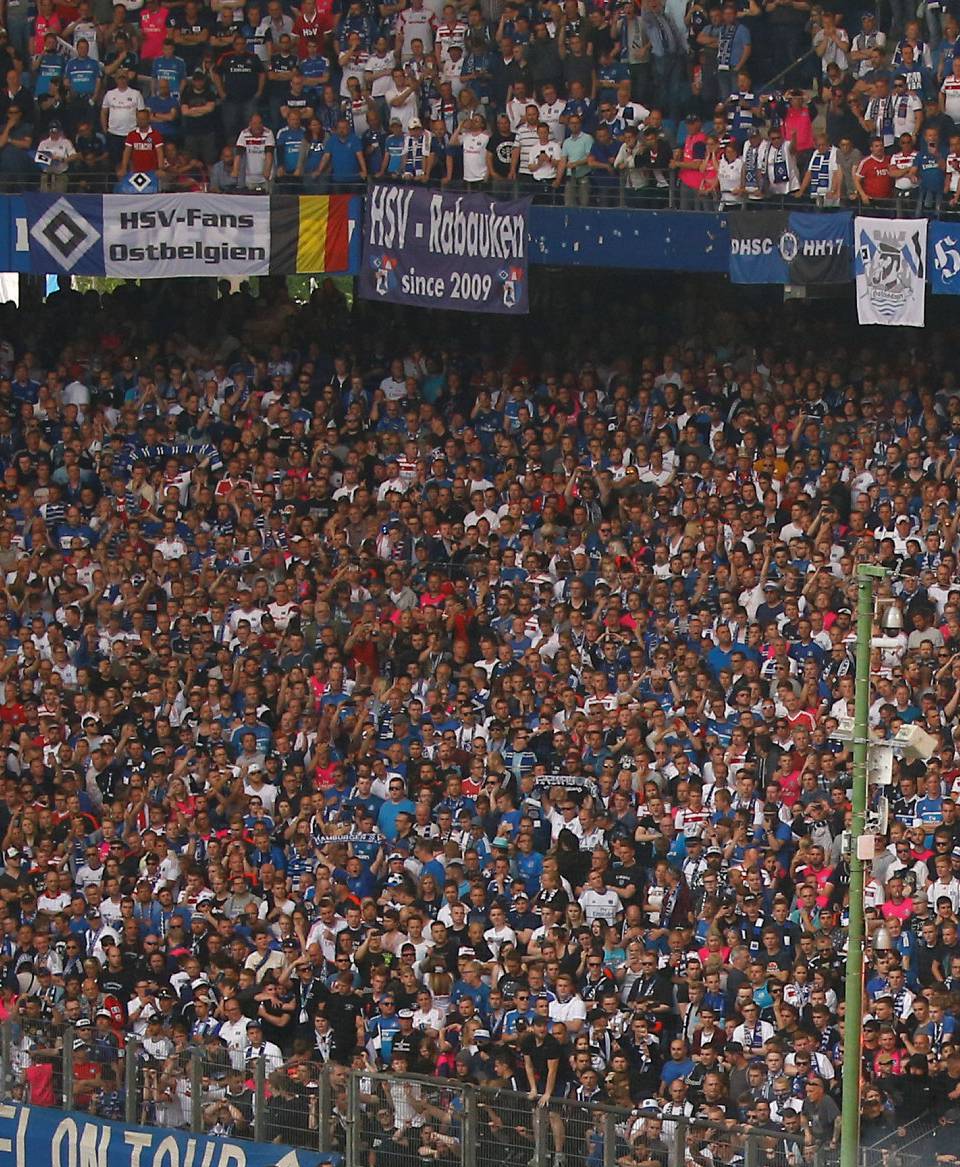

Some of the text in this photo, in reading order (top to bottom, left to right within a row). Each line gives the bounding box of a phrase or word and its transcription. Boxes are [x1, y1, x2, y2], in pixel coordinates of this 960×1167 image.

[120, 208, 254, 230] HSV-Fans
[369, 184, 410, 250] HSV
[428, 194, 526, 258] Rabauken
[109, 241, 266, 265] Ostbelgien
[730, 238, 773, 257] DHSC
[401, 271, 492, 300] since 2009
